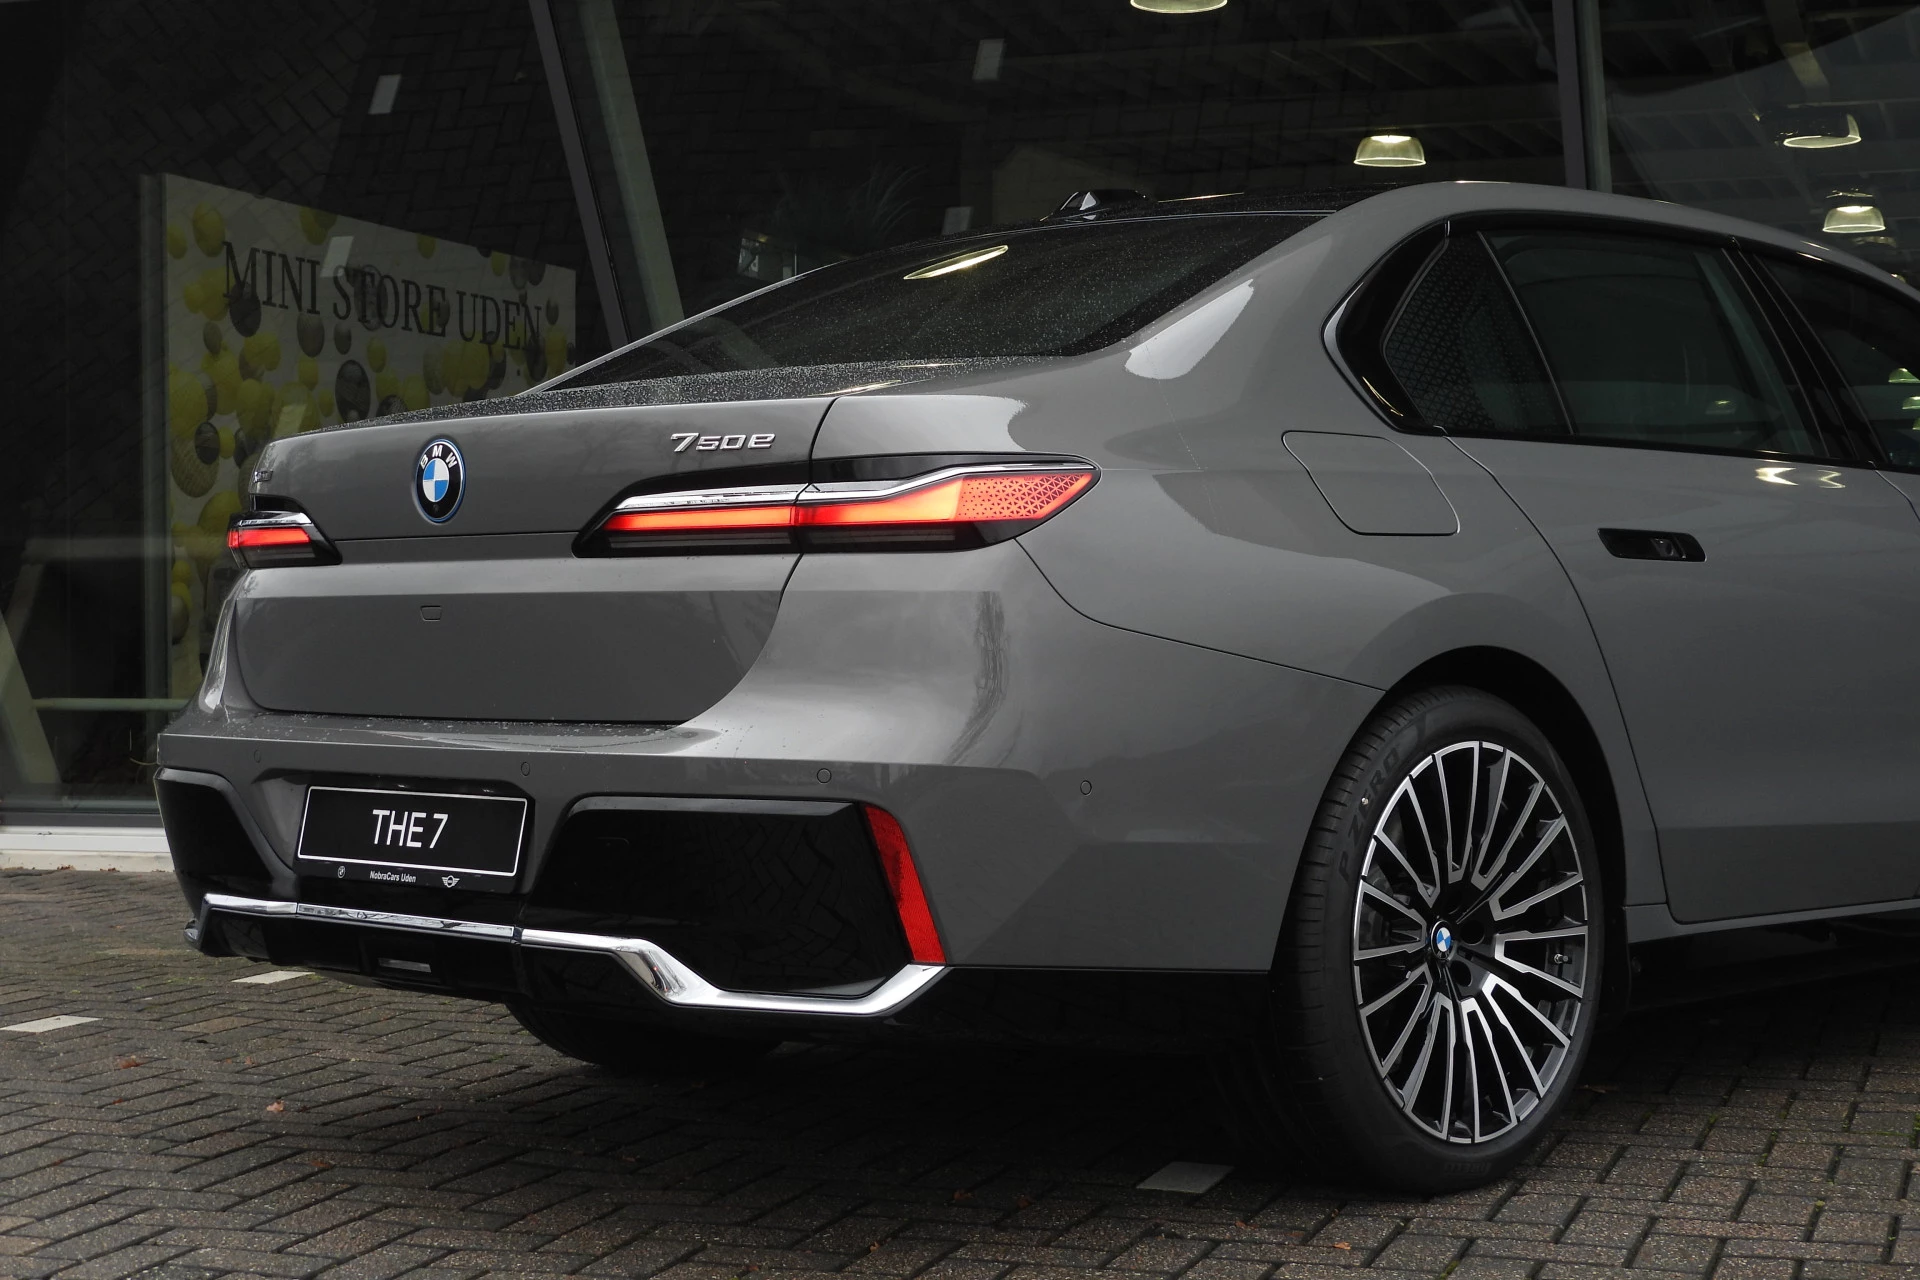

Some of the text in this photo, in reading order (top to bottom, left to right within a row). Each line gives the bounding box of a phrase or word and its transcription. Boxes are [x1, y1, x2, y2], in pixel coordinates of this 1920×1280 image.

[221, 241, 542, 351] MINI STORE UDEN
[420, 444, 458, 470] BMW
[372, 809, 449, 849] THE 7
[369, 870, 417, 883] NobraCars Uden
